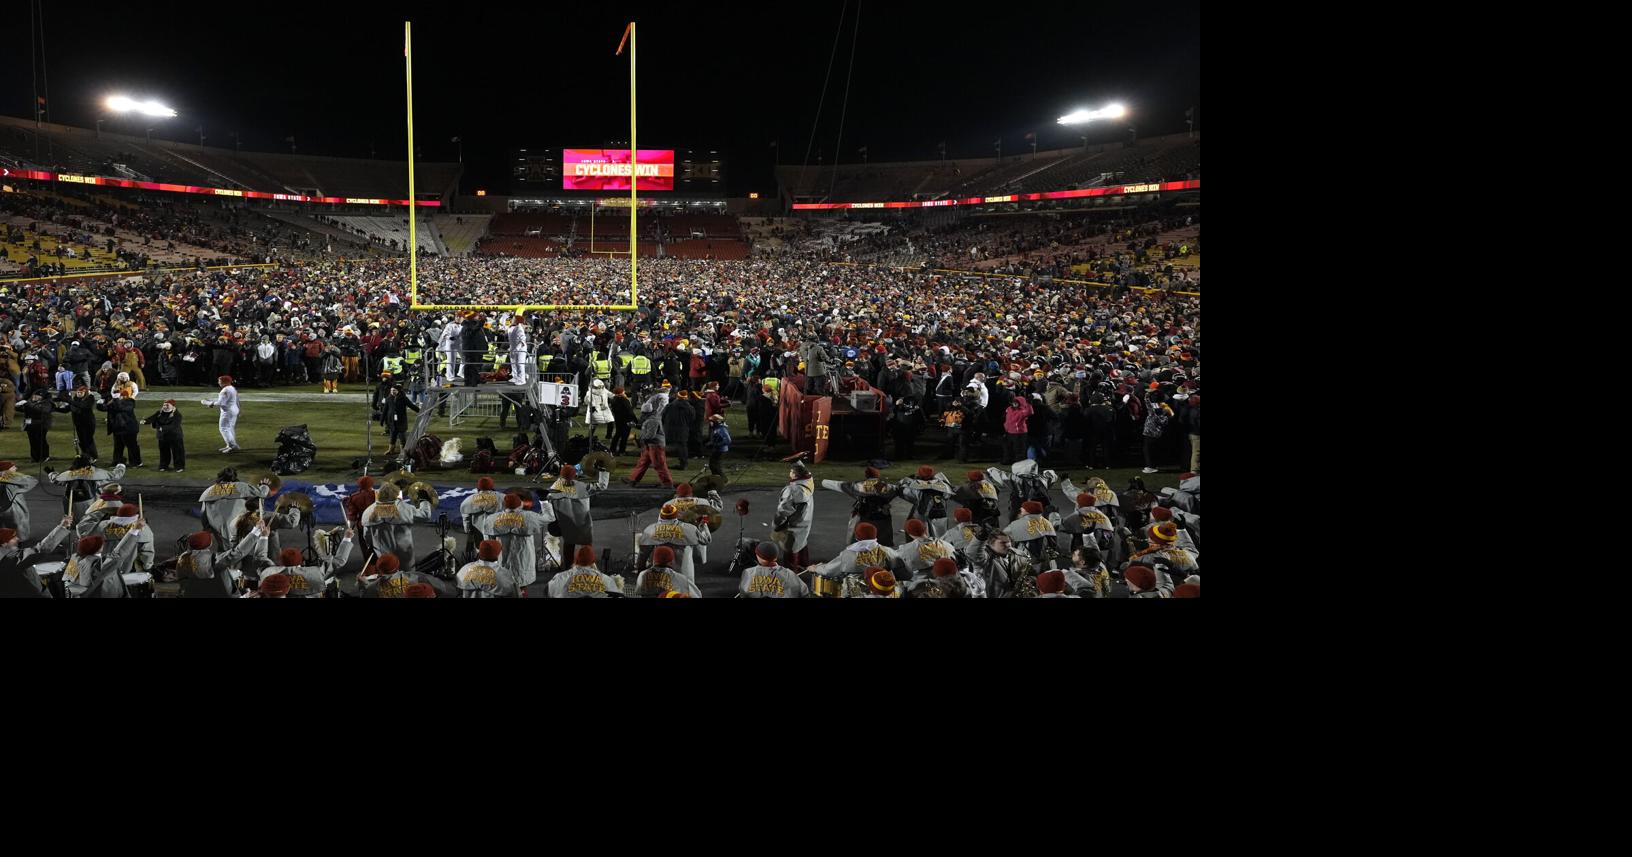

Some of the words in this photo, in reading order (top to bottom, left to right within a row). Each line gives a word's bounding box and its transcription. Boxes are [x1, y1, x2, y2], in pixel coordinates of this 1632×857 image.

[576, 164, 632, 176] CYCLONES
[636, 164, 658, 176] WIN
[58, 174, 84, 183] CYCLONES
[1124, 185, 1148, 193] CYCLONES
[656, 524, 683, 532] IOWA
[572, 573, 604, 583] IOWA
[751, 576, 782, 584] IOWA
[567, 583, 607, 593] STATE
[748, 584, 785, 596] STATE
